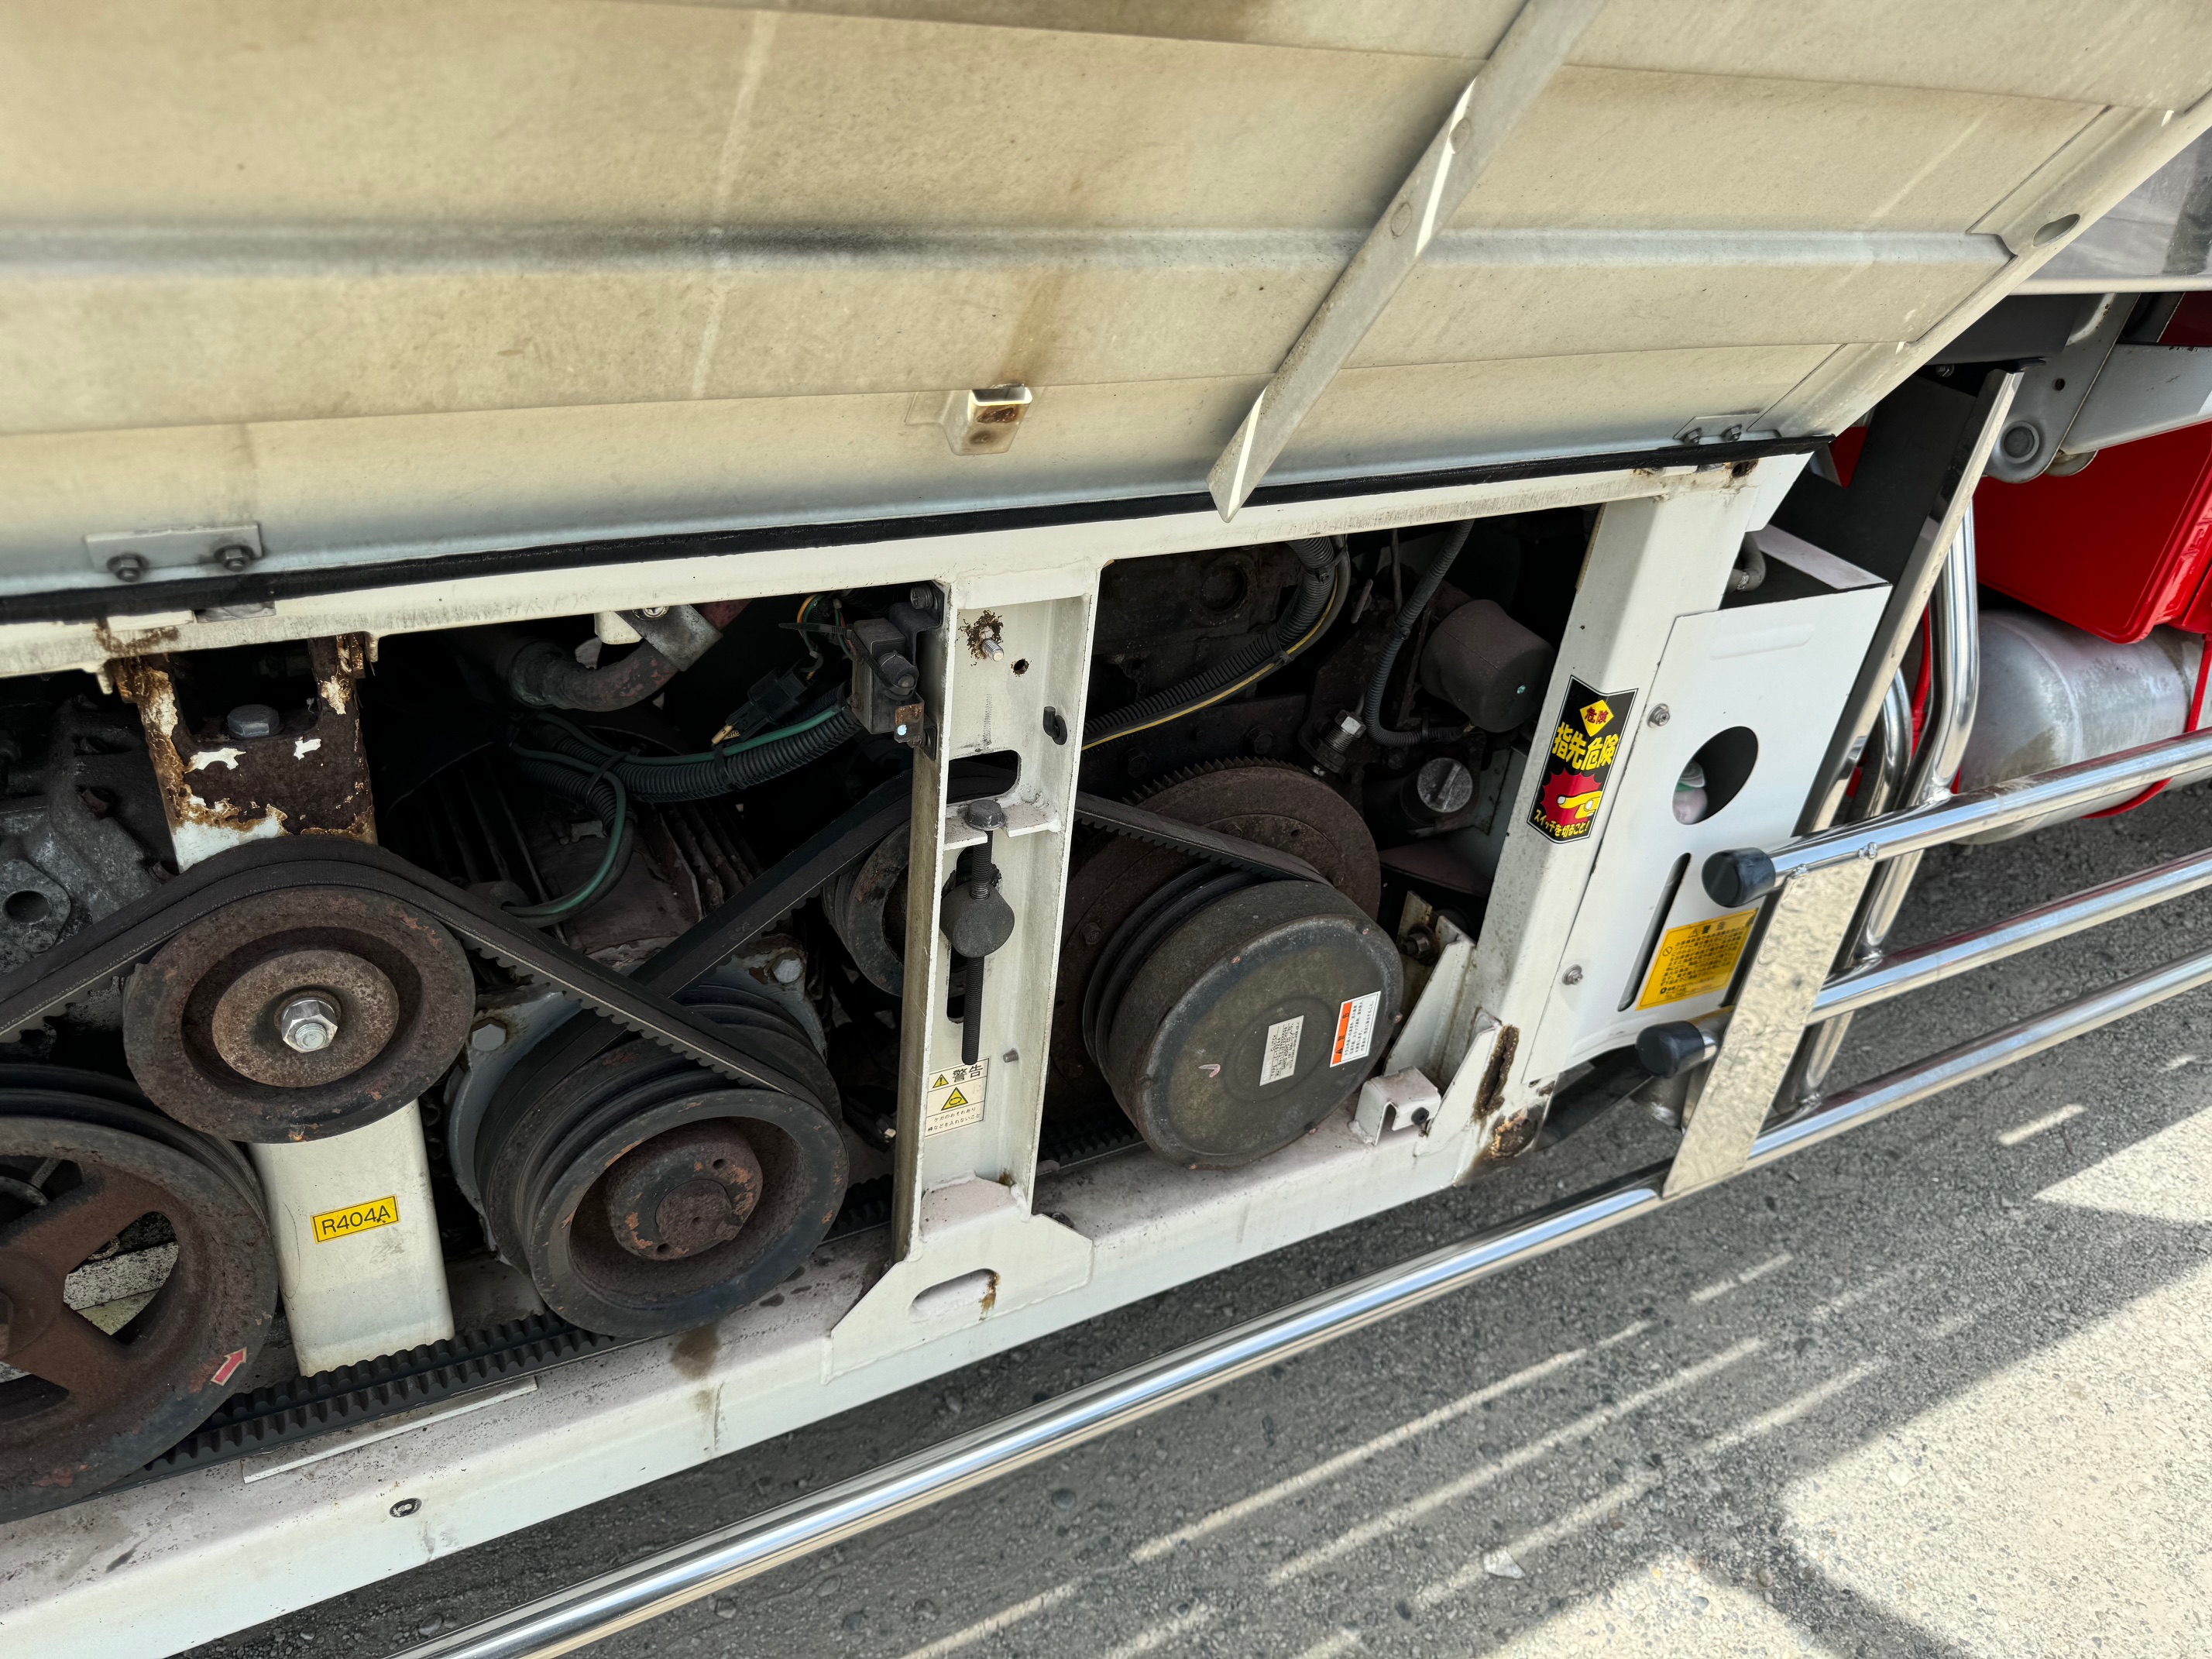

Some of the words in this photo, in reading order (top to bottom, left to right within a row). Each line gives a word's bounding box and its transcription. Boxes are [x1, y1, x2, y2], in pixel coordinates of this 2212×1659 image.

[1584, 706, 1609, 725] 危険
[1551, 721, 1620, 771] 指先危険
[952, 1064, 984, 1083] 警告
[933, 1107, 976, 1123] ケガのおそれあり
[321, 1204, 392, 1235] R404A
